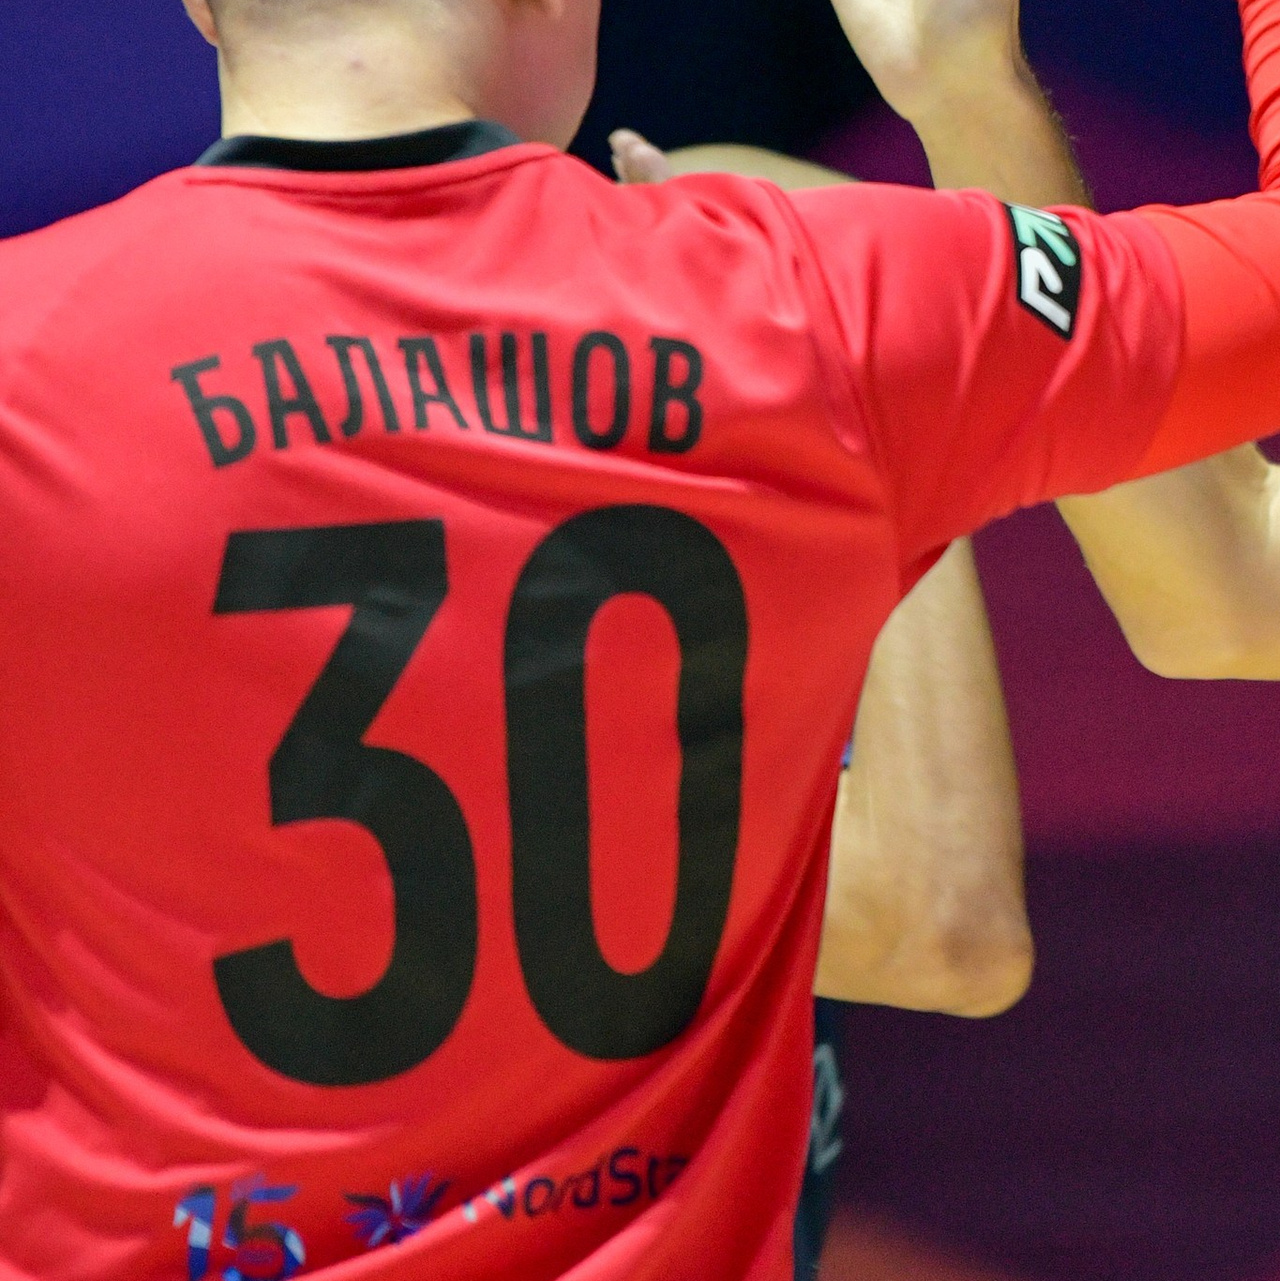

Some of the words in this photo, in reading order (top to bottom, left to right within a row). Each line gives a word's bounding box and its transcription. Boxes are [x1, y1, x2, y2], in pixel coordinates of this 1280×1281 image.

[1010, 206, 1077, 332] PA
[171, 330, 705, 469] БАЛАШОВ
[211, 503, 749, 1087] 30
